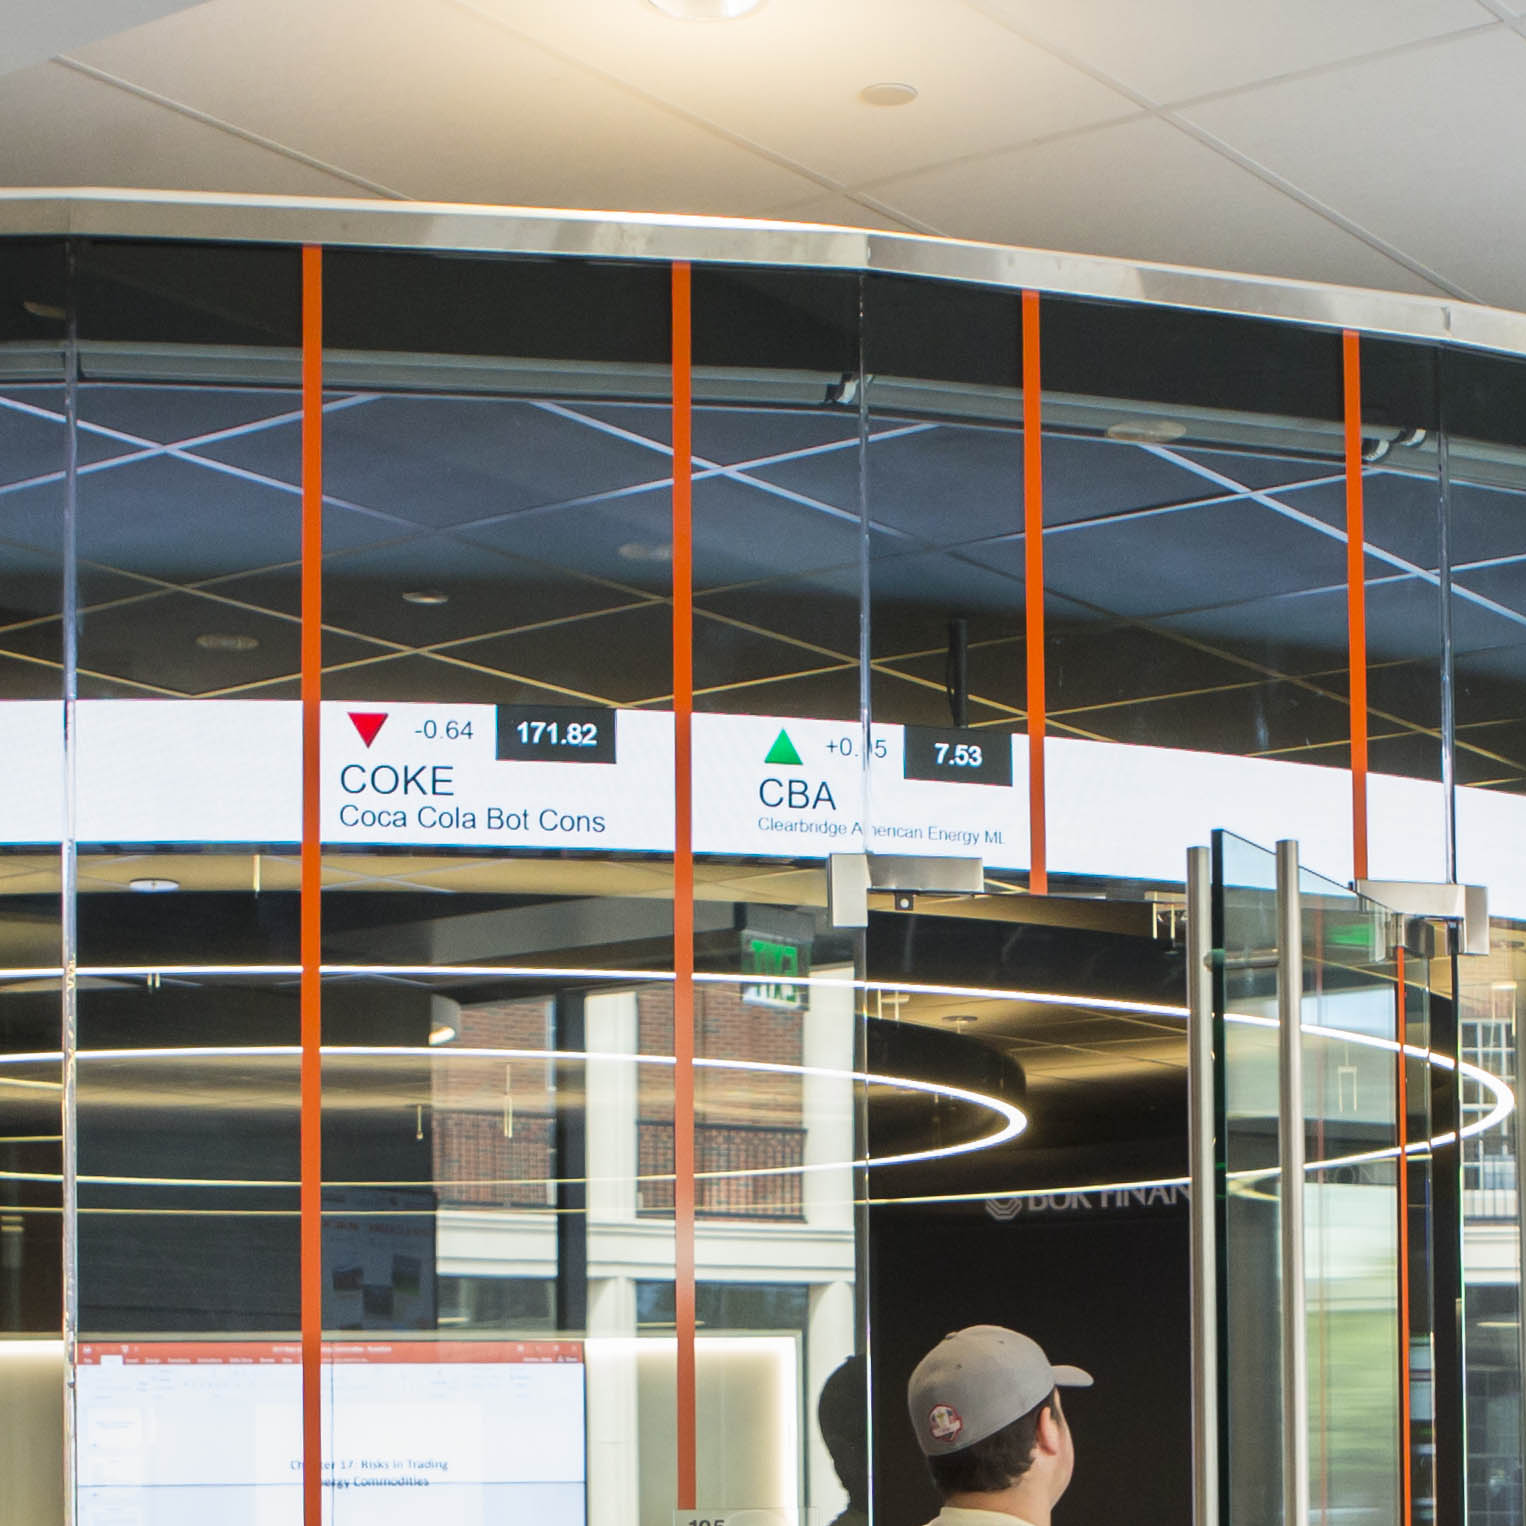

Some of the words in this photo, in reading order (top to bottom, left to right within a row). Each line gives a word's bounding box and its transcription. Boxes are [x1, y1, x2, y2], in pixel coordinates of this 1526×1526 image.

[414, 719, 474, 740] -0.64
[516, 721, 598, 746] 171.82
[826, 737, 887, 759] +0.5
[934, 741, 983, 767] 7.53
[340, 764, 455, 796] COKE
[759, 777, 837, 811] CBA
[339, 804, 407, 829] Coca
[417, 805, 476, 830] Cola
[487, 807, 530, 831] Bot
[539, 809, 606, 834] Cons
[757, 816, 848, 838] Clearbridge
[851, 820, 923, 840] Aerican
[928, 825, 980, 846] Energy
